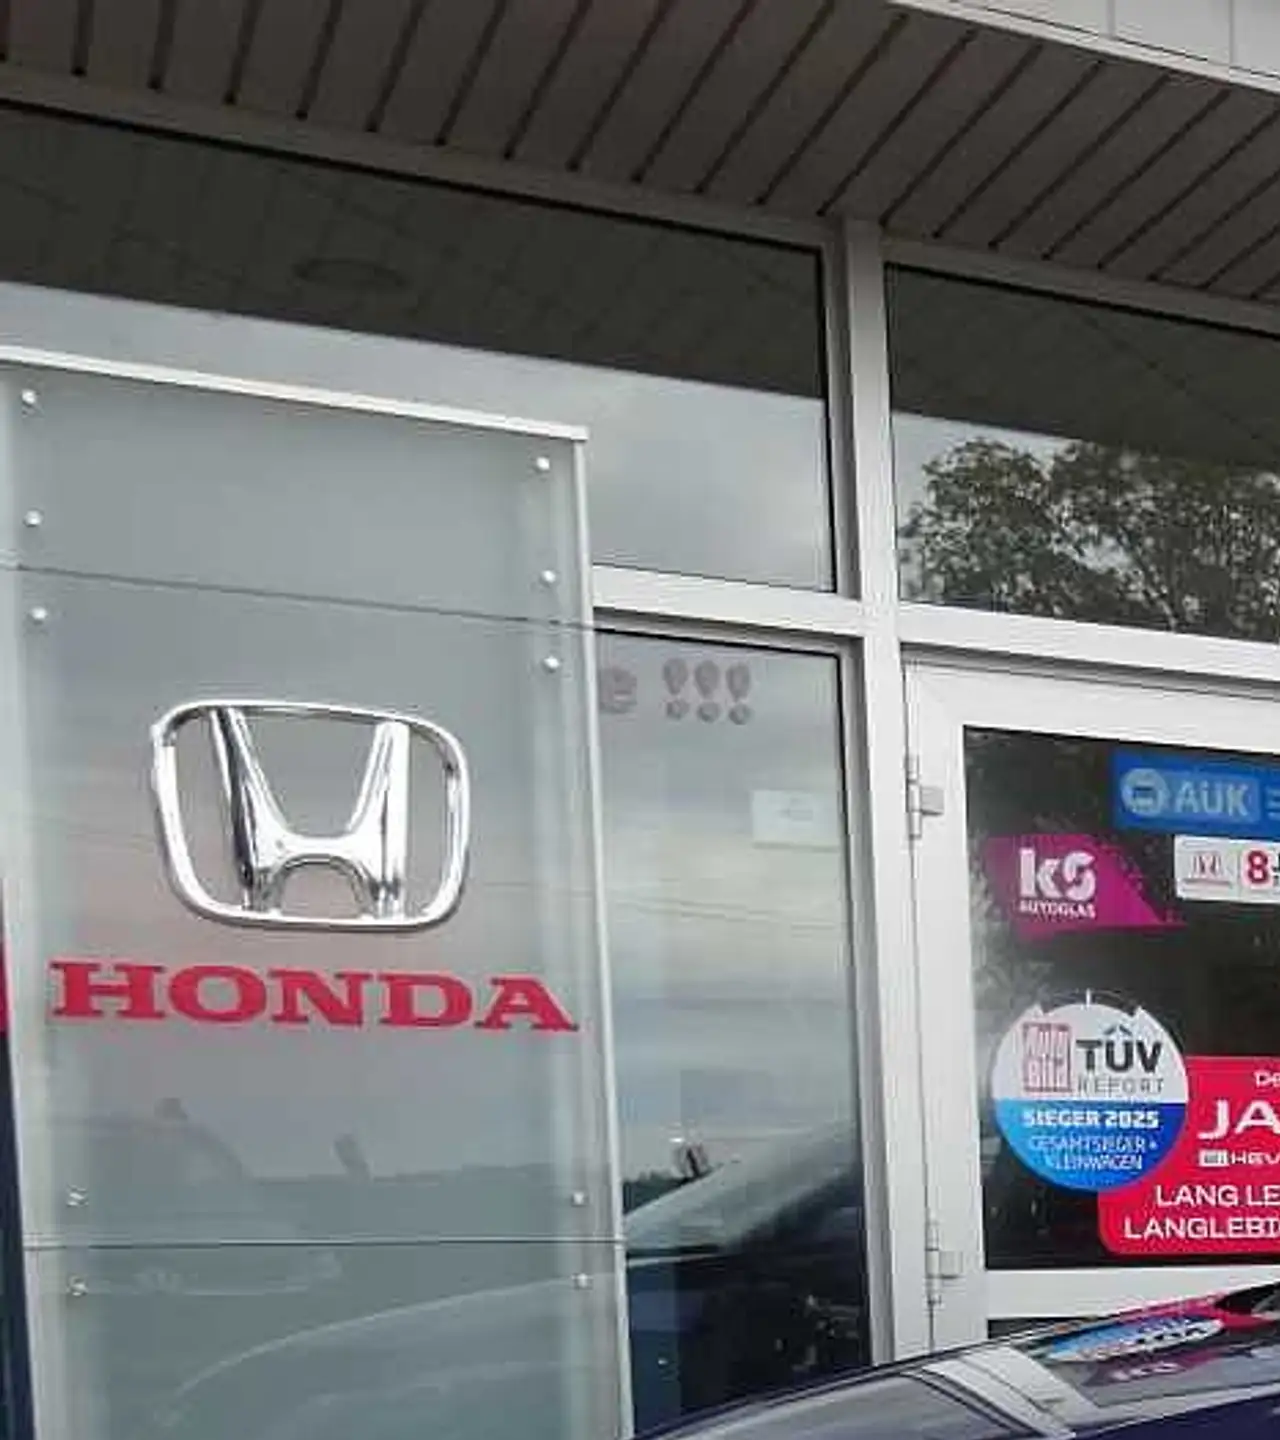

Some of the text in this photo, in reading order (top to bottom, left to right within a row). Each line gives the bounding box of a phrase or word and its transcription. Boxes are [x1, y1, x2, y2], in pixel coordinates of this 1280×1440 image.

[1247, 849, 1269, 885] 8
[50, 961, 579, 1032] HONDA
[1076, 1025, 1162, 1073] TÜV
[1078, 1076, 1163, 1096] REPORT
[1022, 1110, 1160, 1129] SIEGER 2025
[1156, 1184, 1239, 1208] LANG
